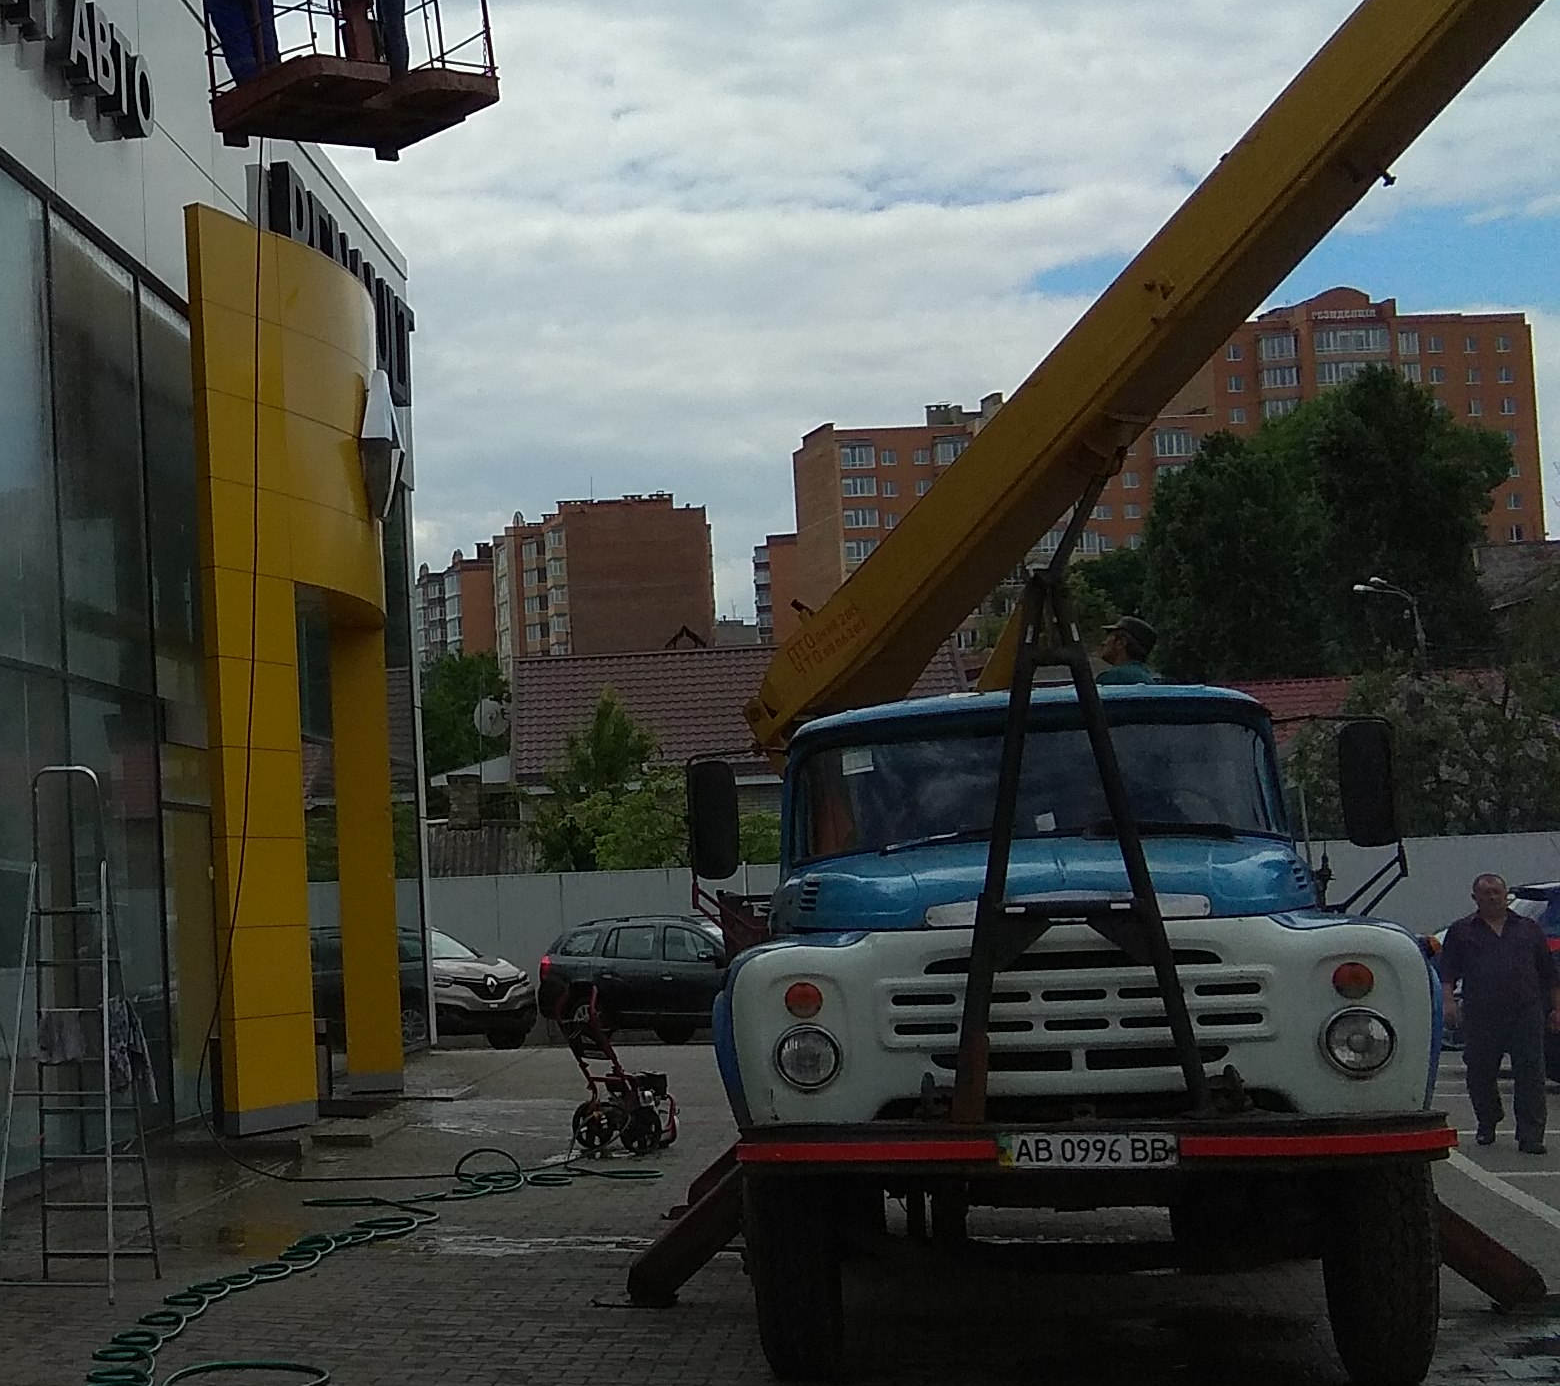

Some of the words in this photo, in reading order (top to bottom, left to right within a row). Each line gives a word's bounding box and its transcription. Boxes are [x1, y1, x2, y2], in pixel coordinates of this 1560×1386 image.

[1016, 1138, 1053, 1162] AB
[1060, 1138, 1122, 1163] 0996
[1130, 1138, 1170, 1162] BB
